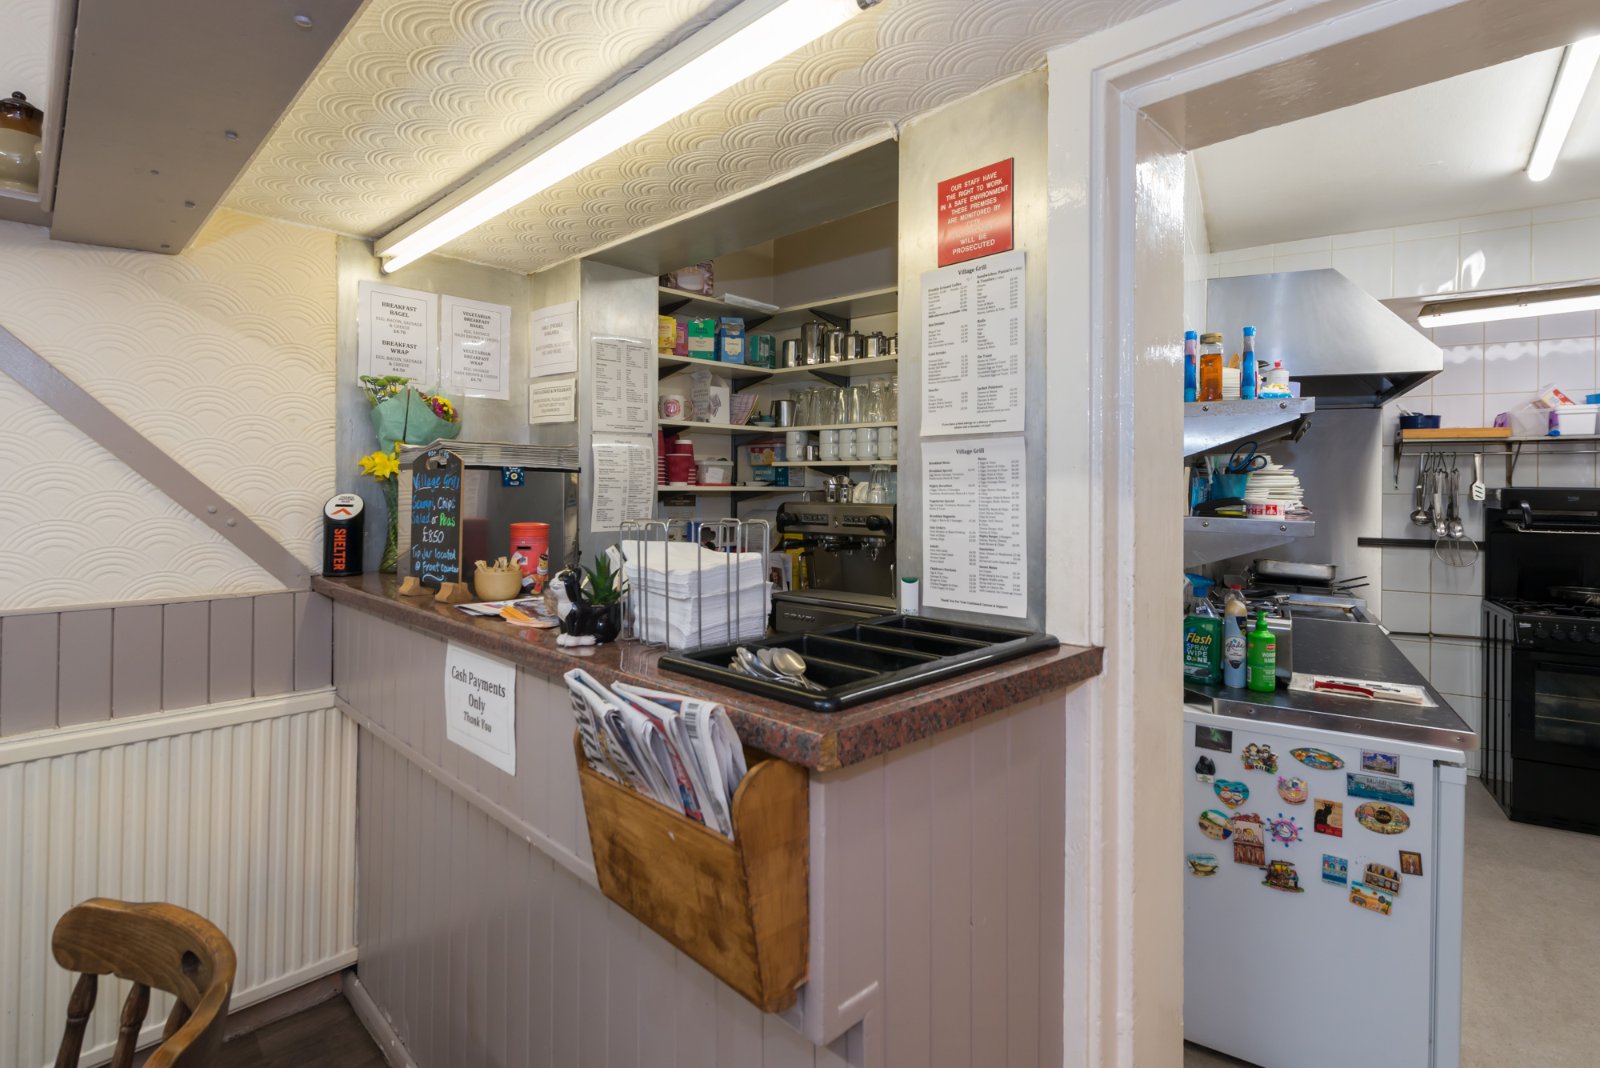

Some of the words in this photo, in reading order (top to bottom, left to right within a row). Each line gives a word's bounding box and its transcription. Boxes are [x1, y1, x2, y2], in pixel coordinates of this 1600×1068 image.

[950, 184, 962, 192] OUR
[964, 178, 980, 186] STAFF
[983, 172, 998, 181] HAVE
[958, 188, 974, 197] RIGHT
[986, 178, 1003, 188] WORK
[954, 199, 967, 207] SAFE
[970, 185, 1008, 203] ENVIRONMENT
[951, 207, 968, 215] THESE
[970, 198, 997, 209] PREMISES
[960, 208, 991, 220] MONITORED
[952, 239, 995, 255] PROSECUTED
[381, 301, 417, 312] BREAKFAST
[389, 310, 409, 318] BAGEL
[382, 340, 417, 350] BREAKFAST
[413, 473, 441, 490] Village
[437, 497, 455, 512] Chips
[431, 515, 439, 524] or
[440, 512, 456, 527] Peas
[333, 528, 347, 571] SHELTER
[435, 548, 456, 560] located
[1185, 632, 1212, 645] Flash
[451, 666, 468, 683] Cash
[468, 672, 506, 698] Payments
[468, 694, 486, 715] Only
[464, 711, 480, 728] Thank
[481, 718, 492, 733] You
